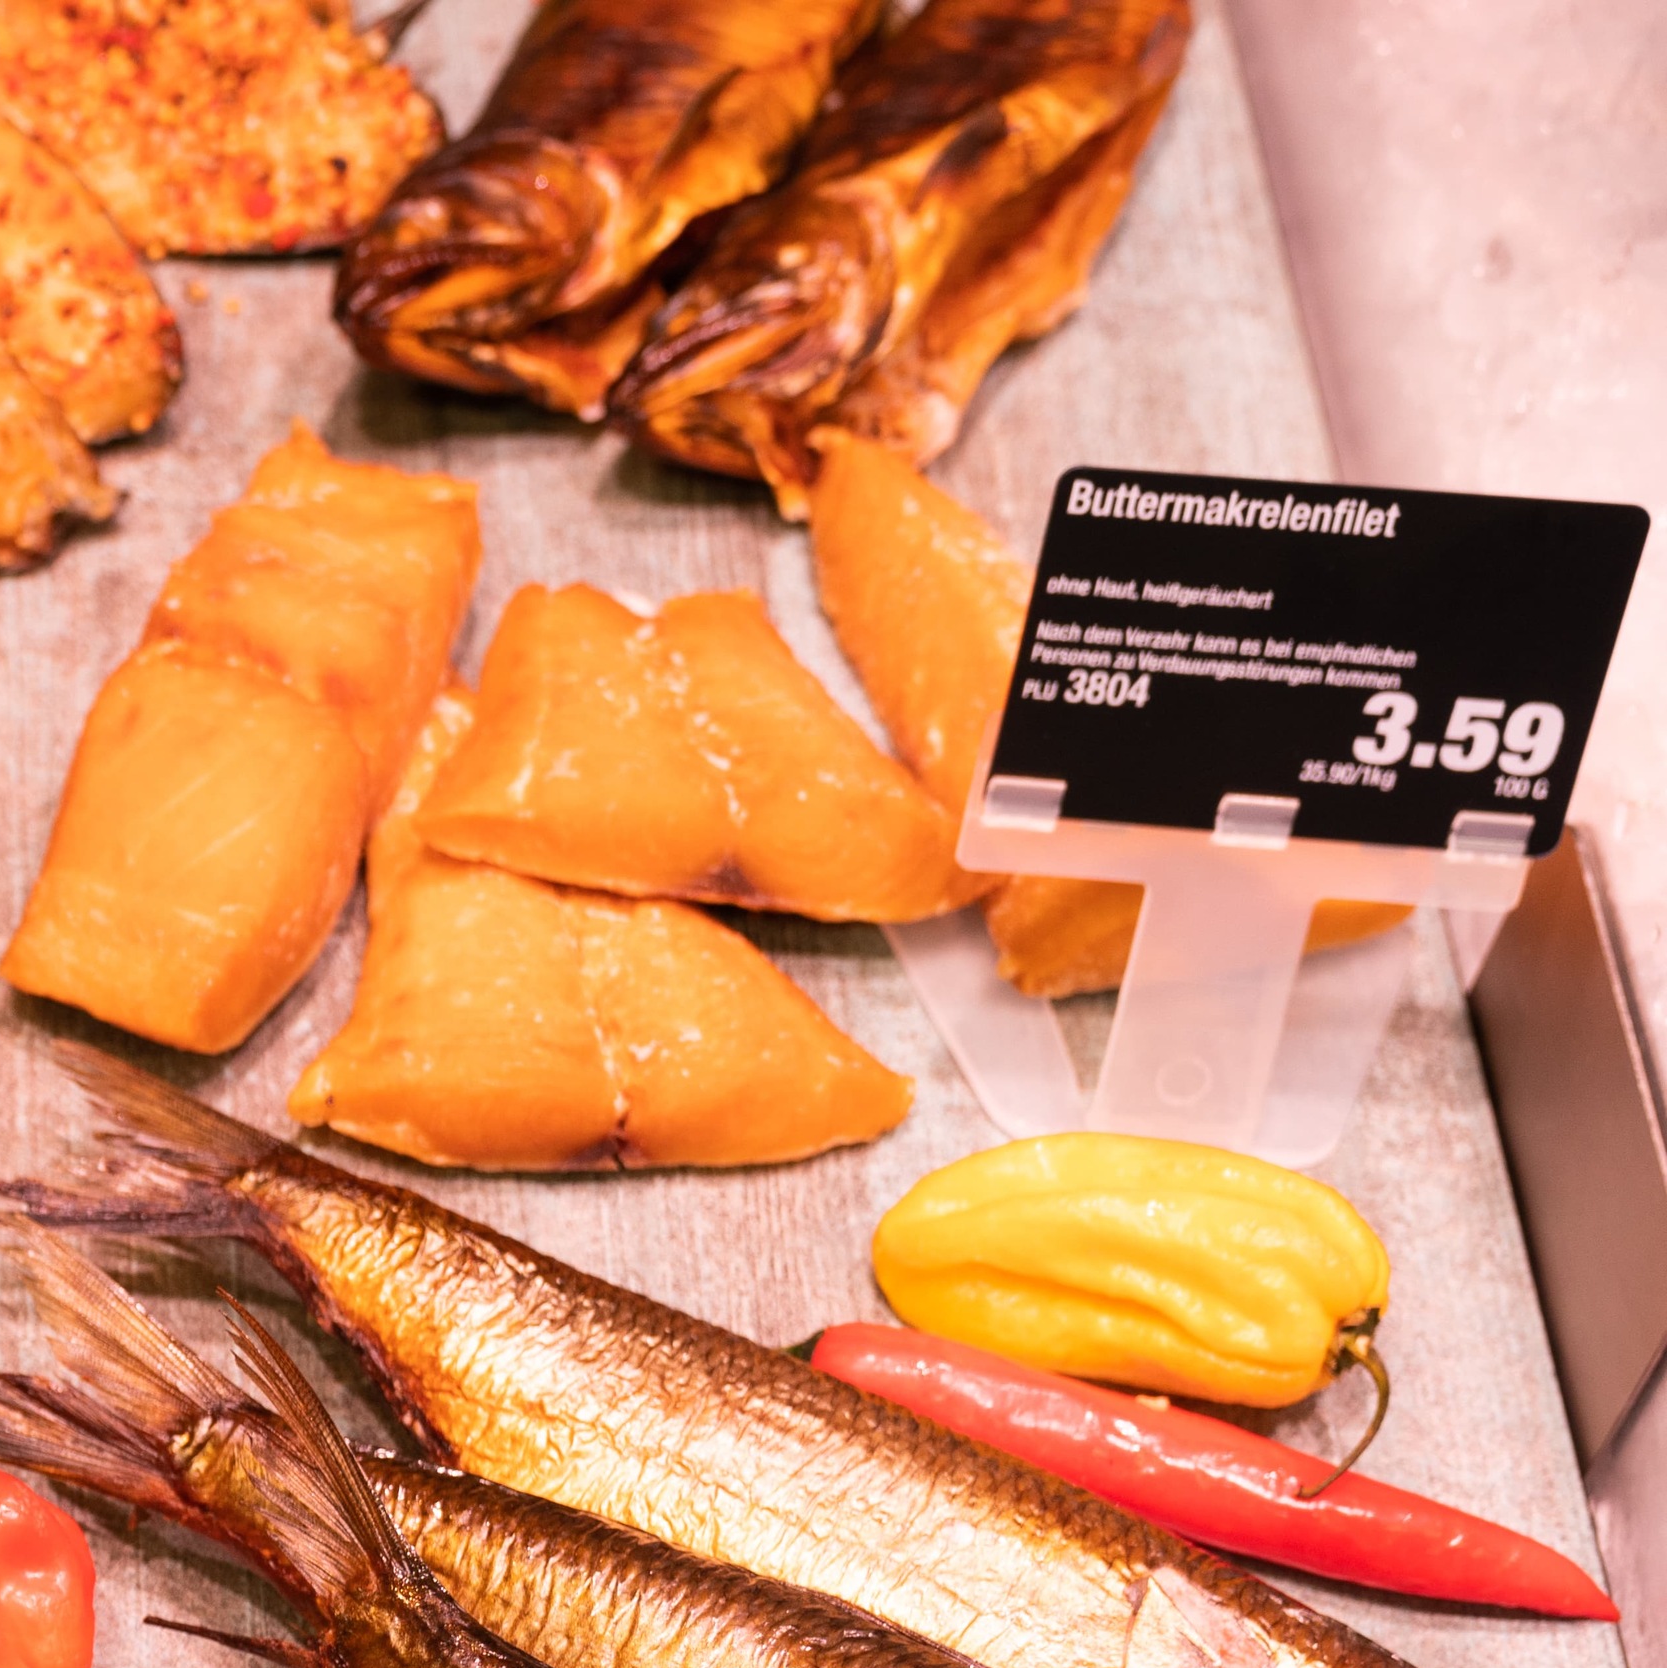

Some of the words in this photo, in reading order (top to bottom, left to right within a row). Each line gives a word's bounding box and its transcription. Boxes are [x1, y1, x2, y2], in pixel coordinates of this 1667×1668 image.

[1067, 478, 1401, 538] Buttermakrelenfilet
[1046, 573, 1092, 597] ohne
[1094, 577, 1140, 601] Haut,
[1030, 642, 1113, 669] Personen
[1113, 650, 1137, 669] zu
[1138, 650, 1324, 686] Verdauungsstörungen
[1324, 665, 1402, 691] kommen
[1036, 619, 1082, 643] Nach
[1083, 622, 1123, 646] dem
[1125, 626, 1193, 651] Verzehr
[1193, 631, 1238, 655] kann
[1239, 638, 1263, 657] es
[1265, 636, 1294, 659] bei
[1294, 640, 1418, 669] empfindlichen
[1023, 677, 1059, 701] PLU
[1064, 668, 1152, 709] 3804
[1352, 691, 1564, 777] 3.59
[1299, 760, 1397, 792] 35.90/1kg
[1493, 775, 1530, 798] 100
[1532, 777, 1548, 800] G
